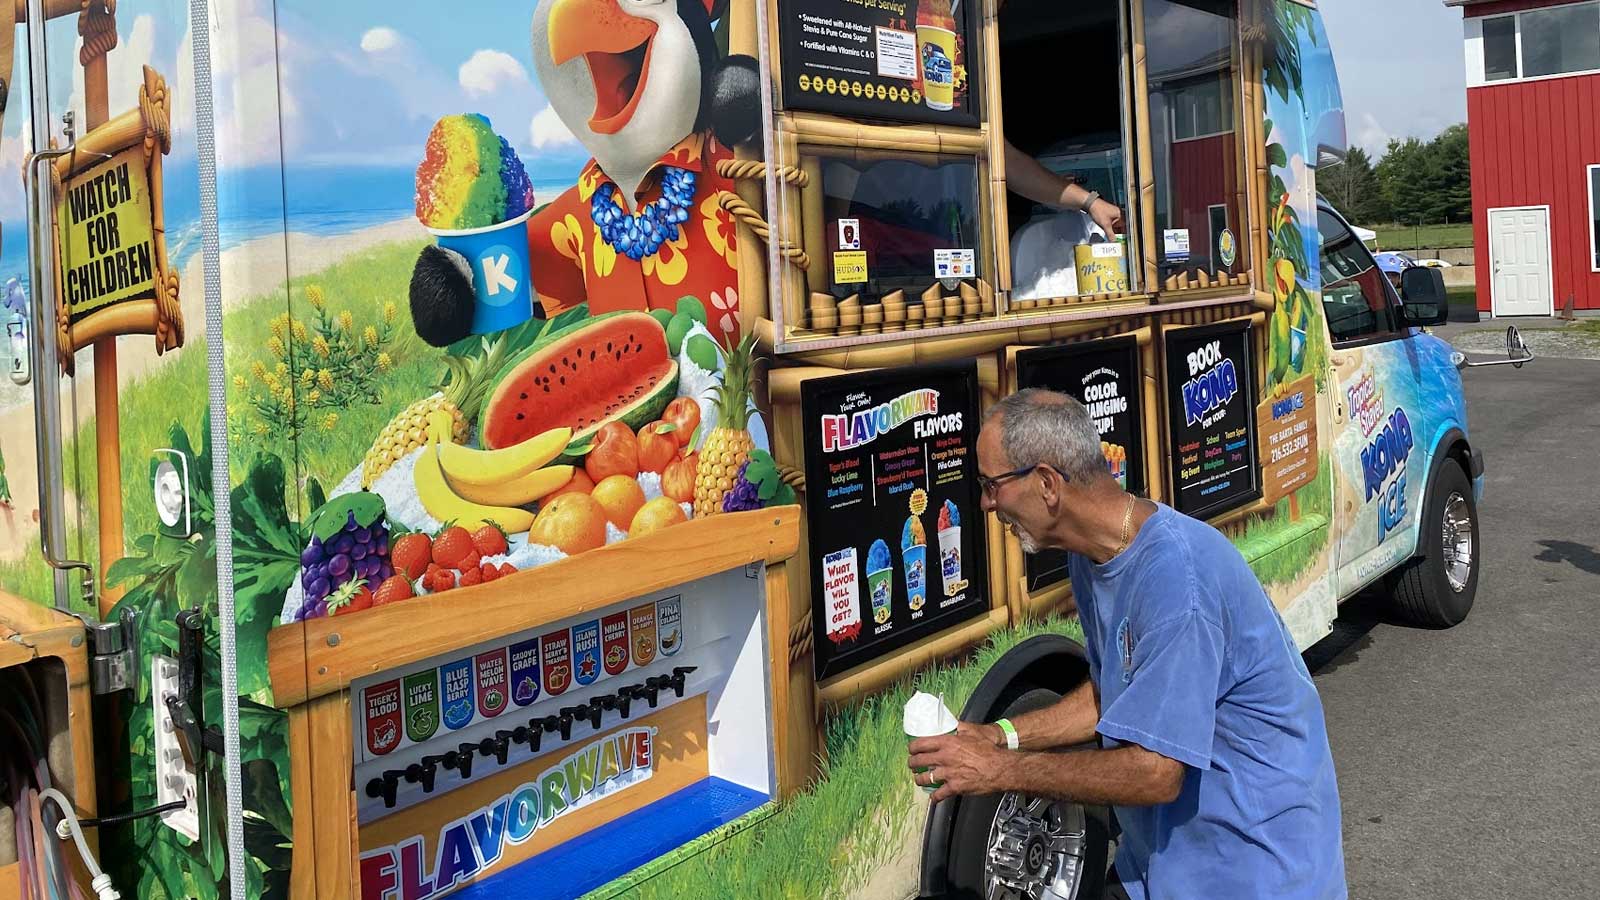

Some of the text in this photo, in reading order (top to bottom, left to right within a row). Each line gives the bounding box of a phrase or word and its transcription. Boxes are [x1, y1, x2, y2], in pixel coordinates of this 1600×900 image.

[802, 13, 871, 33] Sweetened with All-Natural
[802, 24, 868, 43] Stevia & Pure Cane Sugar
[804, 40, 826, 51] Fortified
[826, 44, 838, 53] with
[838, 46, 860, 57] Vitamins
[860, 50, 865, 58] C
[870, 51, 875, 59] D
[69, 163, 131, 225] WATCH
[87, 212, 120, 258] FOR
[68, 241, 152, 306] CHILDREN
[482, 253, 518, 296] K
[836, 265, 865, 274] HUDSON
[1081, 261, 1106, 276] Mr.
[1187, 340, 1222, 376] BOOK
[1084, 381, 1118, 402] COLOR
[1182, 358, 1238, 427] KONA
[1348, 370, 1375, 419] Tropical
[1272, 397, 1292, 421] KONA
[1360, 388, 1384, 438] Shaved
[822, 389, 938, 452] FLAVORWAVE
[914, 412, 963, 439] FLAVORS
[1202, 417, 1212, 429] FOR
[1206, 433, 1220, 445] School
[1225, 431, 1235, 439] Team
[1269, 432, 1279, 446] THE
[1360, 407, 1414, 504] KONA
[831, 471, 858, 484] Lucky Lime
[1189, 465, 1200, 476] Event
[902, 480, 914, 490] Rush
[827, 488, 838, 498] Blue
[1377, 465, 1408, 546] ICE
[826, 552, 842, 564] KONA
[827, 563, 851, 577] WHAT
[825, 573, 855, 591] FLAVOR
[832, 587, 849, 600] WILL
[833, 598, 849, 611] YOU
[632, 613, 653, 624] ORANGE
[832, 609, 852, 624] GET?
[911, 610, 924, 620] KING
[576, 628, 597, 642] ISLAND
[604, 621, 625, 634] NINJA
[874, 621, 893, 635] KLASSIC
[604, 630, 626, 642] CHERRY
[544, 639, 567, 652] STRAW
[576, 638, 597, 653] RUSH
[512, 648, 536, 661] GROOVY
[480, 657, 503, 671] WATER
[512, 657, 537, 671] GRAPE
[446, 666, 468, 683] BLUE
[480, 666, 504, 679] MELON
[446, 678, 469, 694] RASP
[480, 673, 504, 688] WAVE
[409, 682, 432, 695] LUCKY
[447, 689, 469, 702] BERRY
[369, 692, 397, 708] TIGER'S
[409, 690, 433, 707] LIME
[369, 702, 398, 719] BLOOD
[360, 730, 653, 900] FLAVORWAVE
